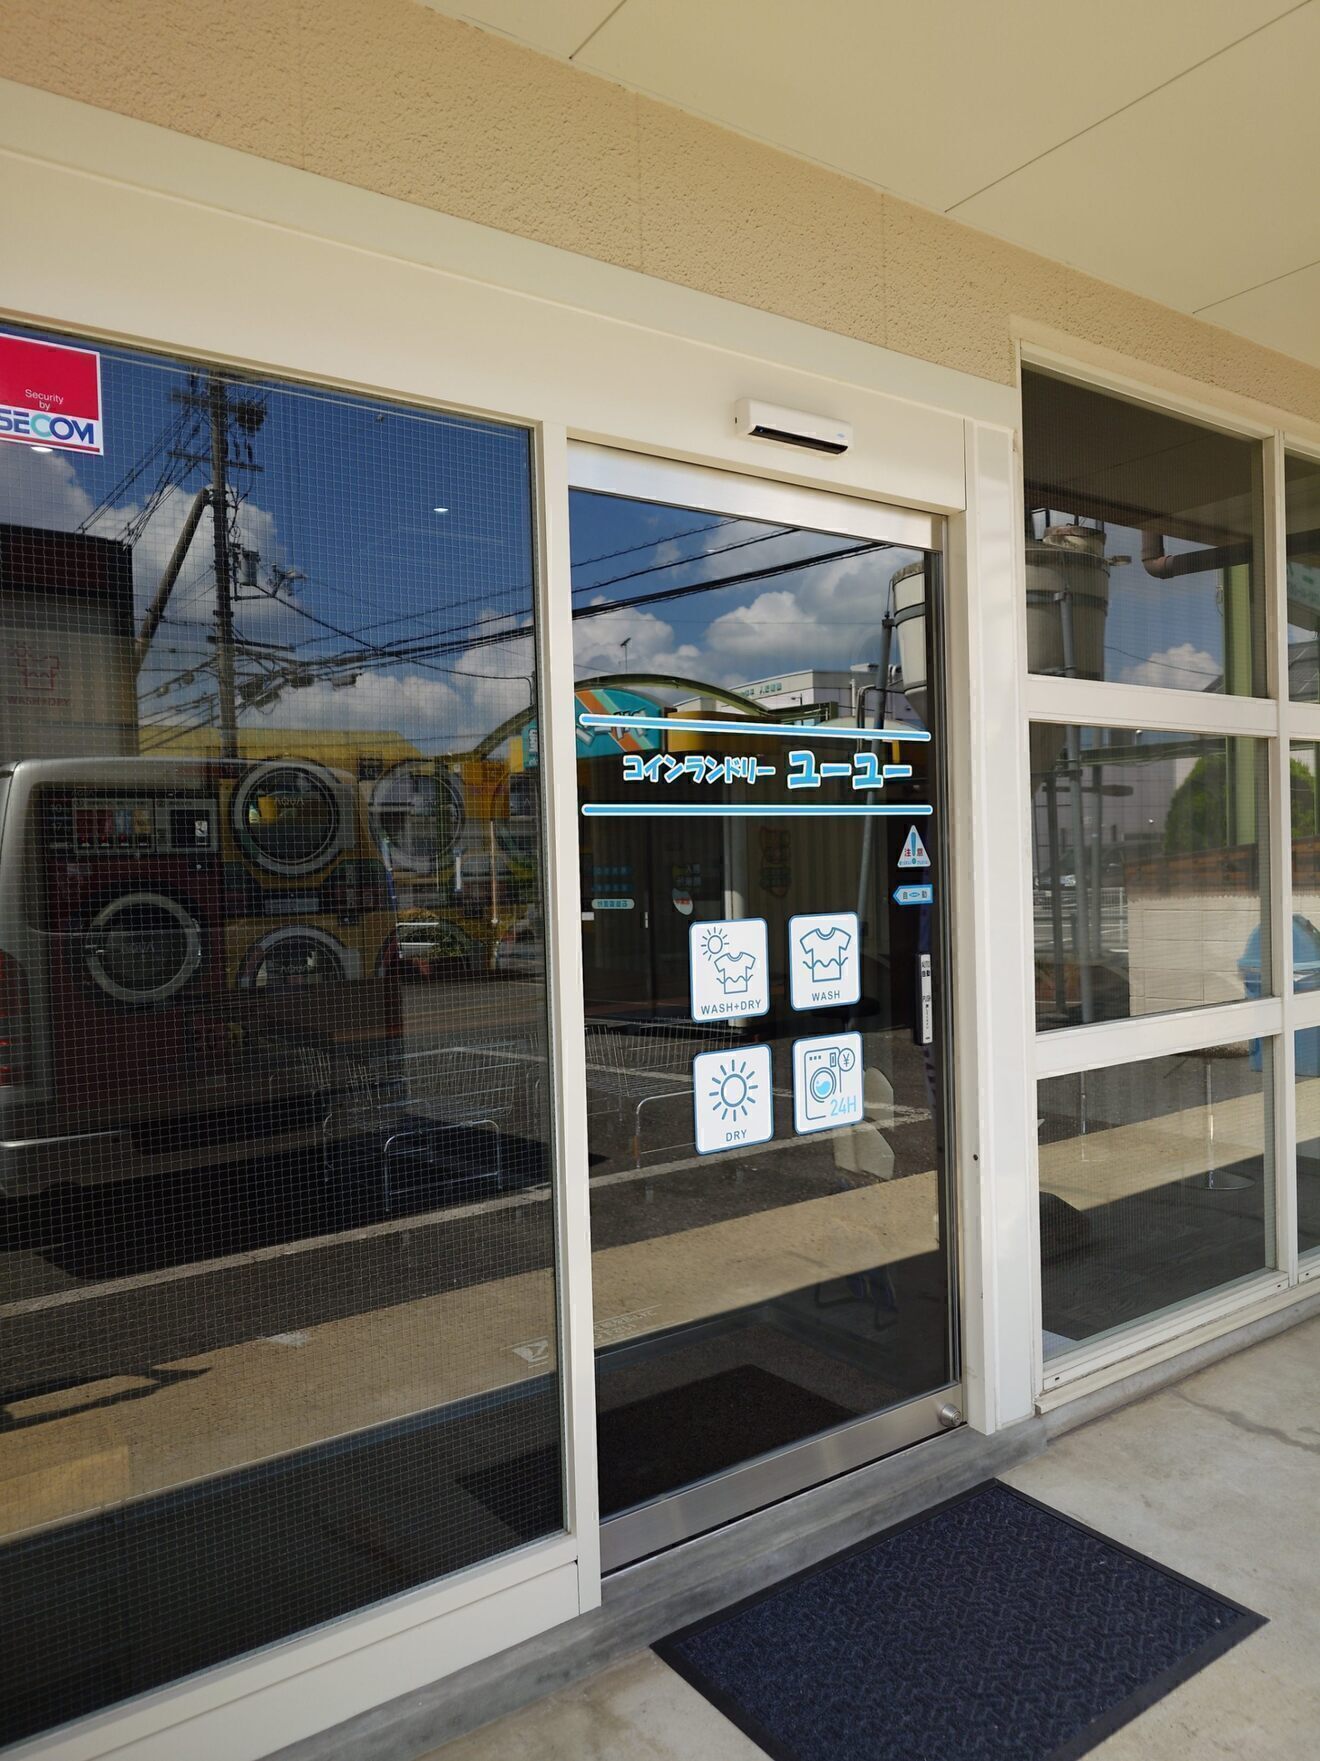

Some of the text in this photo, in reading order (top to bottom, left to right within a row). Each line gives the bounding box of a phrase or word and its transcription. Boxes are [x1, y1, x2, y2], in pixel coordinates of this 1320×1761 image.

[25, 389, 64, 404] Security
[39, 401, 51, 411] by
[623, 750, 912, 789] コインランドリー ユーユー
[811, 990, 841, 1002] WASH
[700, 999, 761, 1016] WASH+DRY
[830, 1095, 858, 1117] 24H
[725, 1129, 748, 1142] DRY
